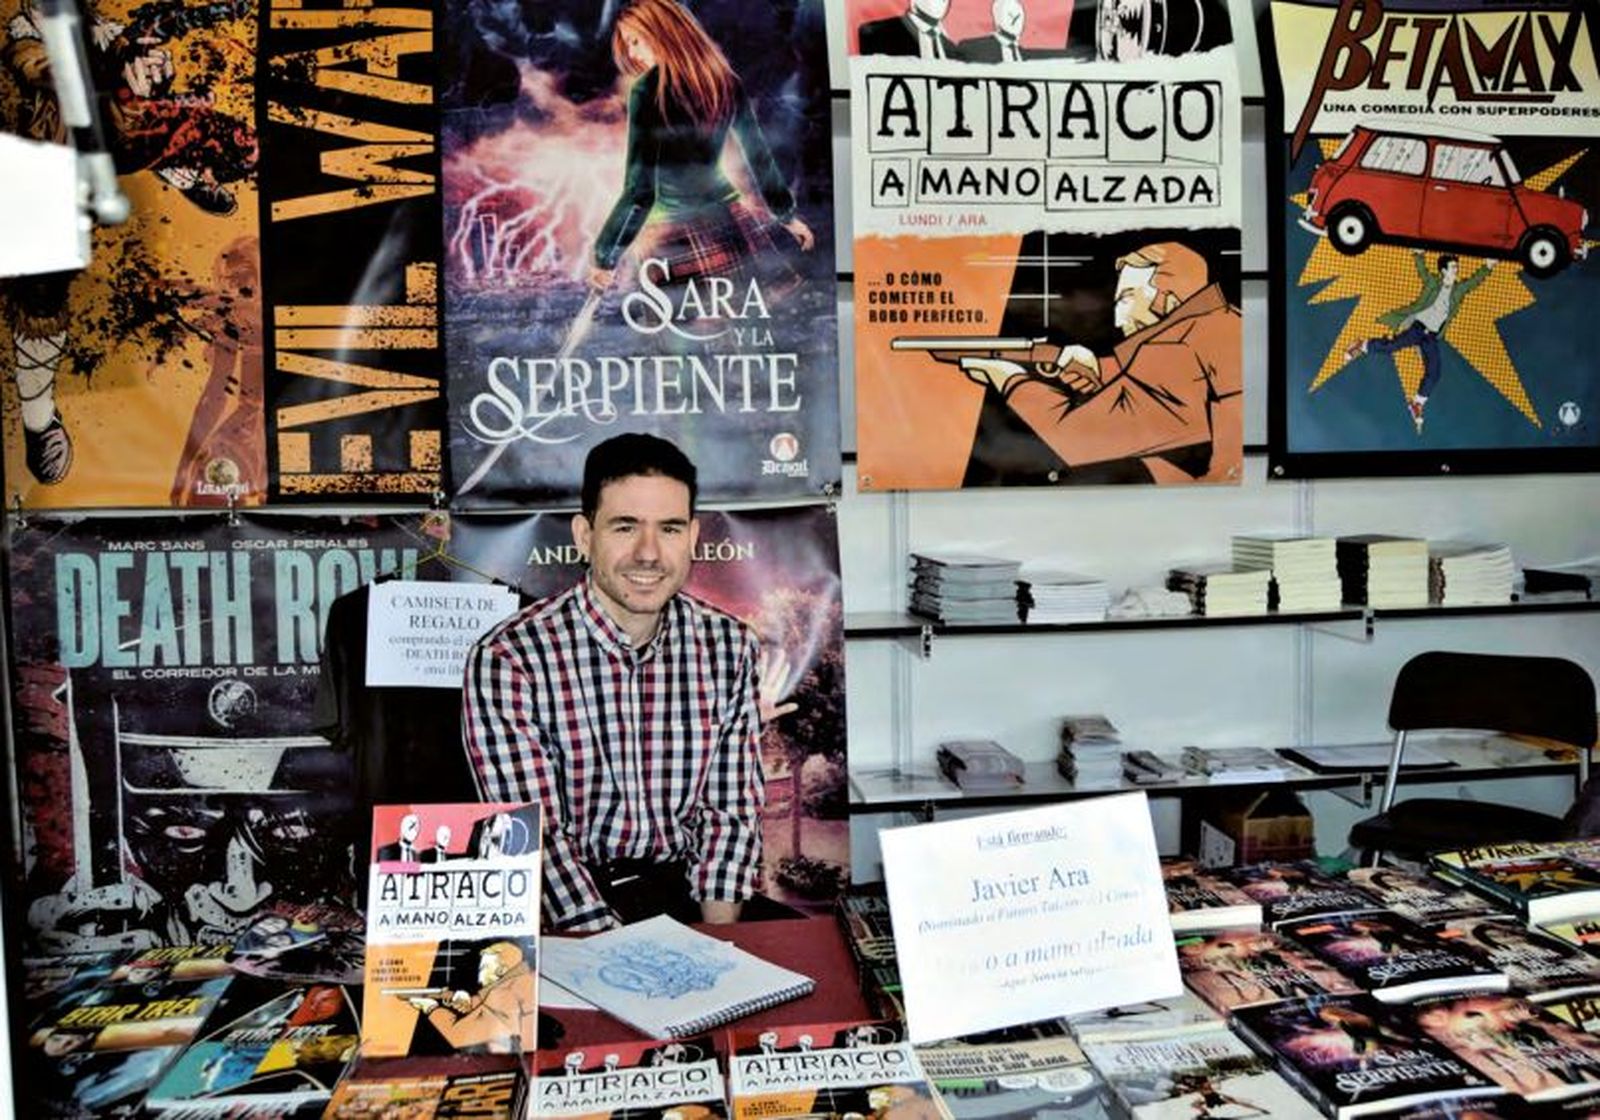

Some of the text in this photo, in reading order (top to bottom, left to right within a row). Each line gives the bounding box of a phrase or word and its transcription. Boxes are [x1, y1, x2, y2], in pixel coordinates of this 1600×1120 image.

[1290, 0, 1583, 160] BETAMAX
[877, 77, 1215, 141] ATRACO
[1323, 104, 1600, 117] UNA COMEDIA CON SUPERPODERES
[880, 167, 1214, 202] A MANO ALZADA
[900, 214, 942, 226] LUNDI
[958, 214, 987, 226] ARA
[868, 291, 955, 304] COMETER EL
[868, 309, 908, 323] ROBO
[734, 328, 774, 347] Y LA
[274, 262, 441, 494] EVIL
[461, 353, 801, 443] SERPIENTE
[107, 540, 204, 551] MARC SANS
[232, 538, 368, 549] OSCAR PERALES
[55, 551, 254, 668] DEATH
[391, 595, 498, 612] CAMISETA DE
[409, 615, 480, 630] REGALO
[112, 671, 136, 680] EL
[142, 667, 237, 679] CORREDOR
[244, 666, 268, 676] DE
[273, 665, 296, 676] LA
[381, 870, 527, 901] ATRACO
[971, 867, 1090, 902] Javier Ara
[379, 911, 525, 927] A MANO ALZADA
[745, 1050, 905, 1074] ATRACO
[545, 1068, 707, 1096] ATRACO
